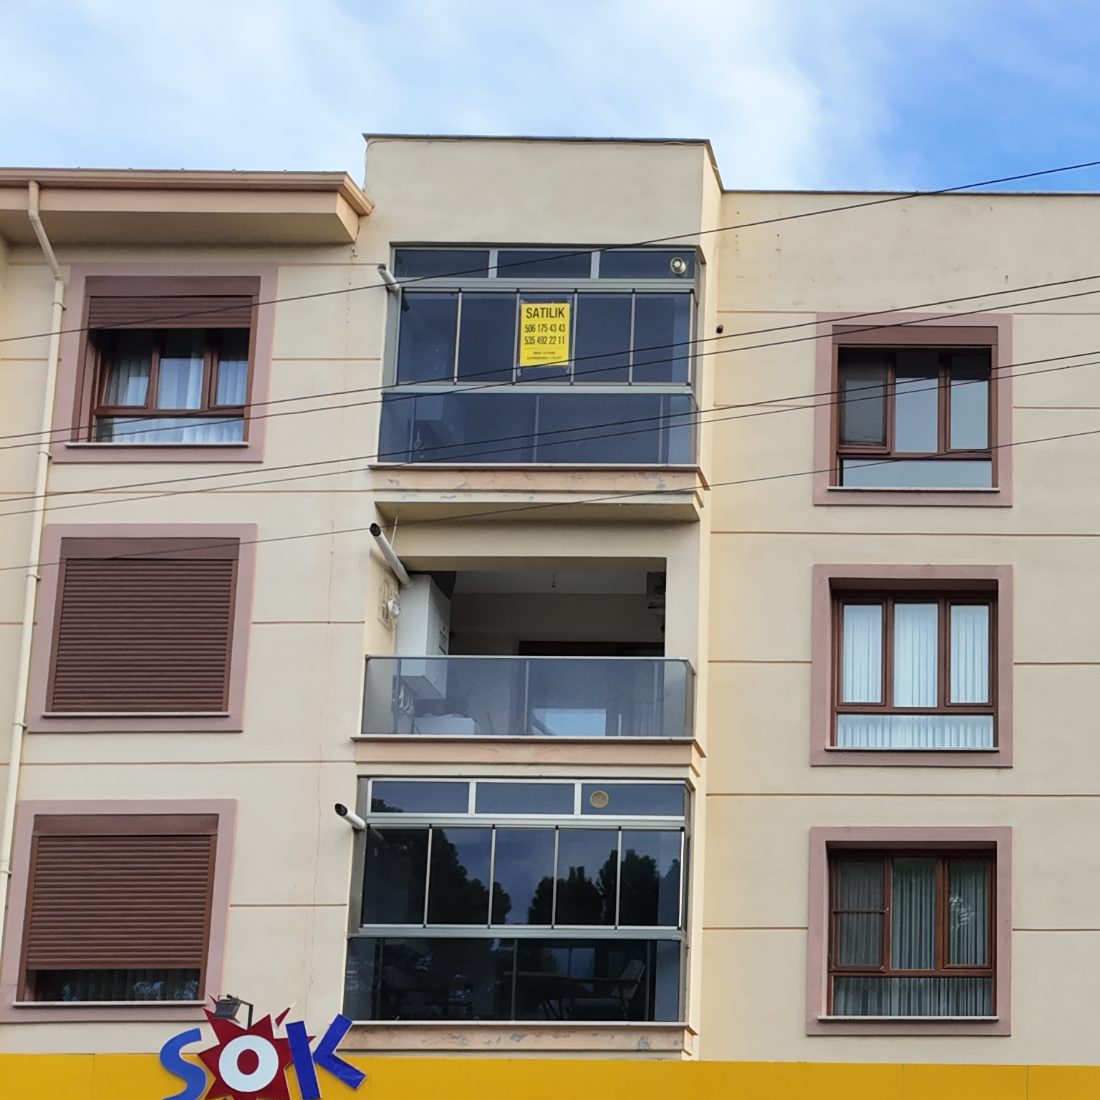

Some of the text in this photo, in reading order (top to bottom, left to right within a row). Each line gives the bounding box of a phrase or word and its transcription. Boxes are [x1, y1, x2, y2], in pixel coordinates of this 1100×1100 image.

[526, 307, 565, 319] SATILIK
[538, 324, 548, 333] 175
[549, 324, 557, 333] 43
[559, 324, 566, 333] 43
[549, 336, 557, 345] 22
[558, 336, 565, 345] 11
